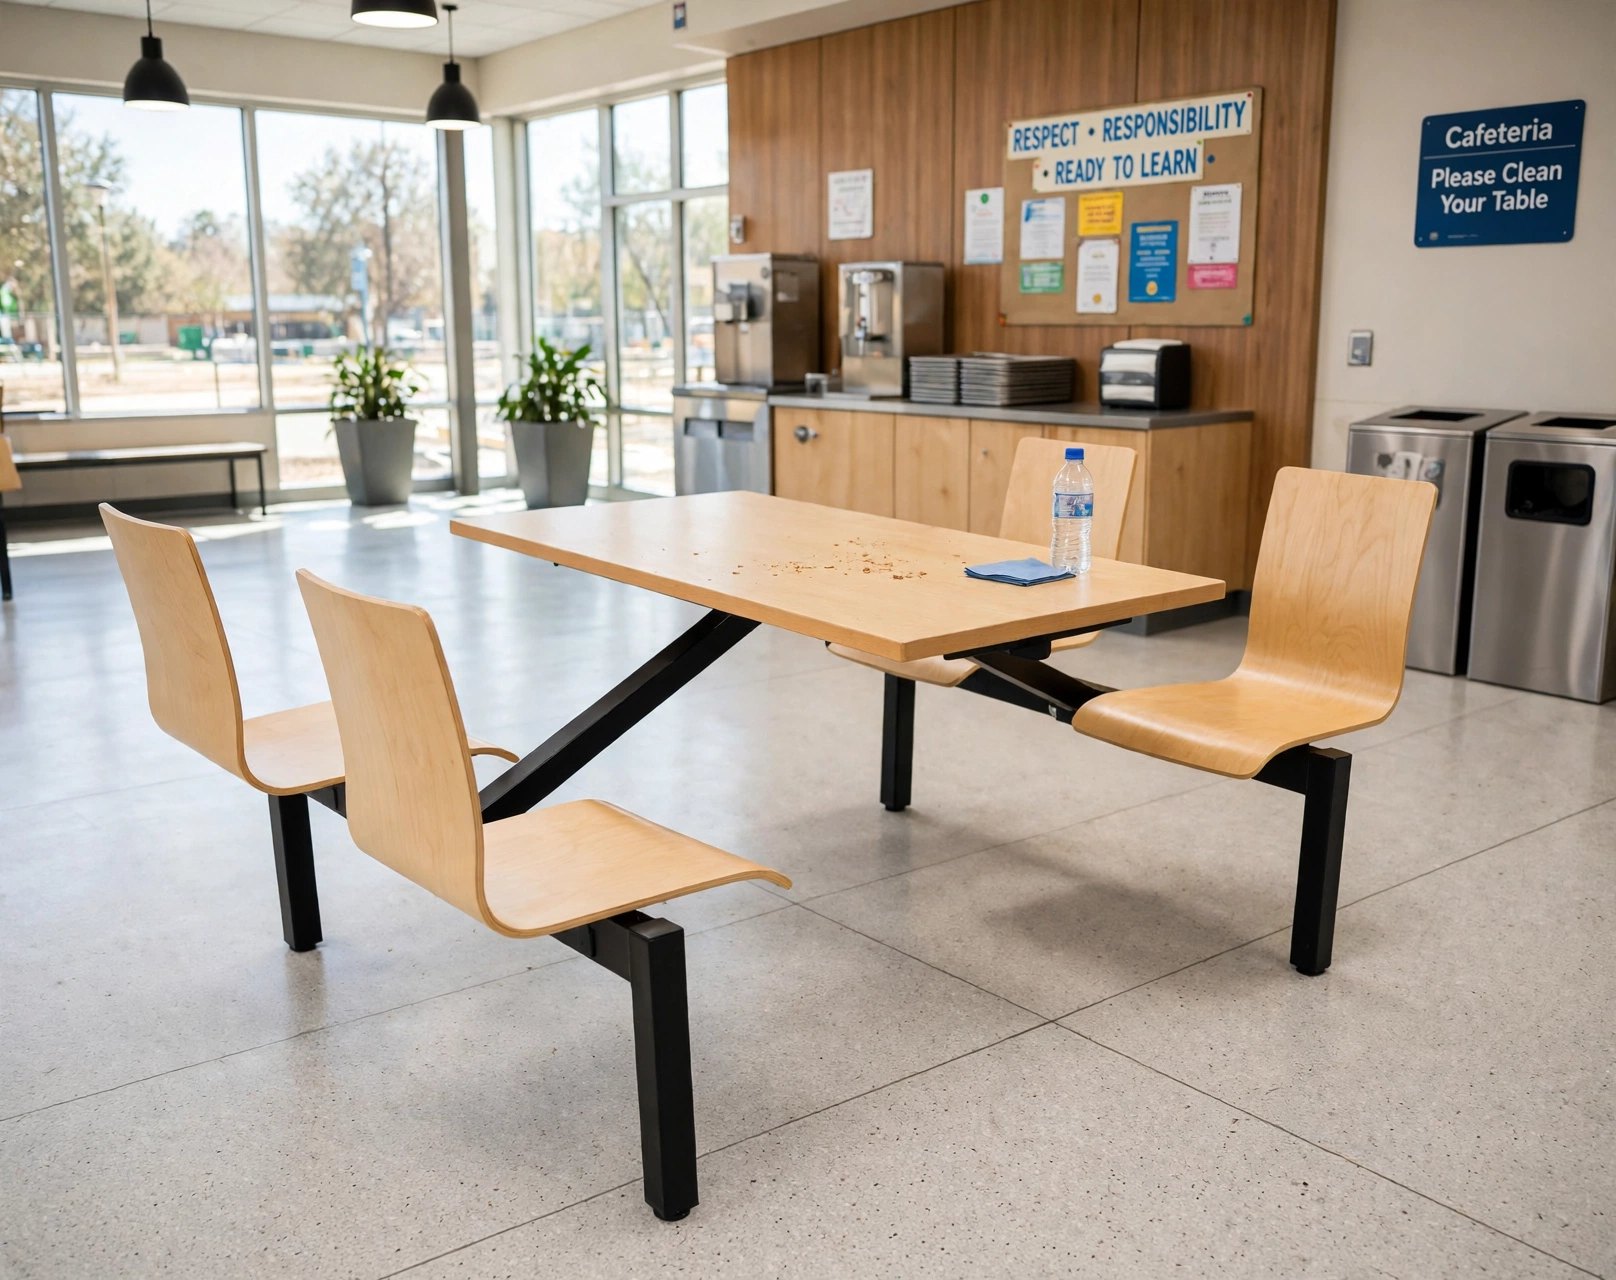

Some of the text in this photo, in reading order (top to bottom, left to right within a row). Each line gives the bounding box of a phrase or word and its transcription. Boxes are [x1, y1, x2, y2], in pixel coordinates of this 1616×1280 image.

[1013, 101, 1246, 152] RESPECT RESPONSIBILITY
[1445, 118, 1553, 149] Cafeteria
[1055, 148, 1198, 184] READY TO LEARN
[1431, 161, 1563, 189] Please Clean
[1441, 188, 1549, 214] Your Table
